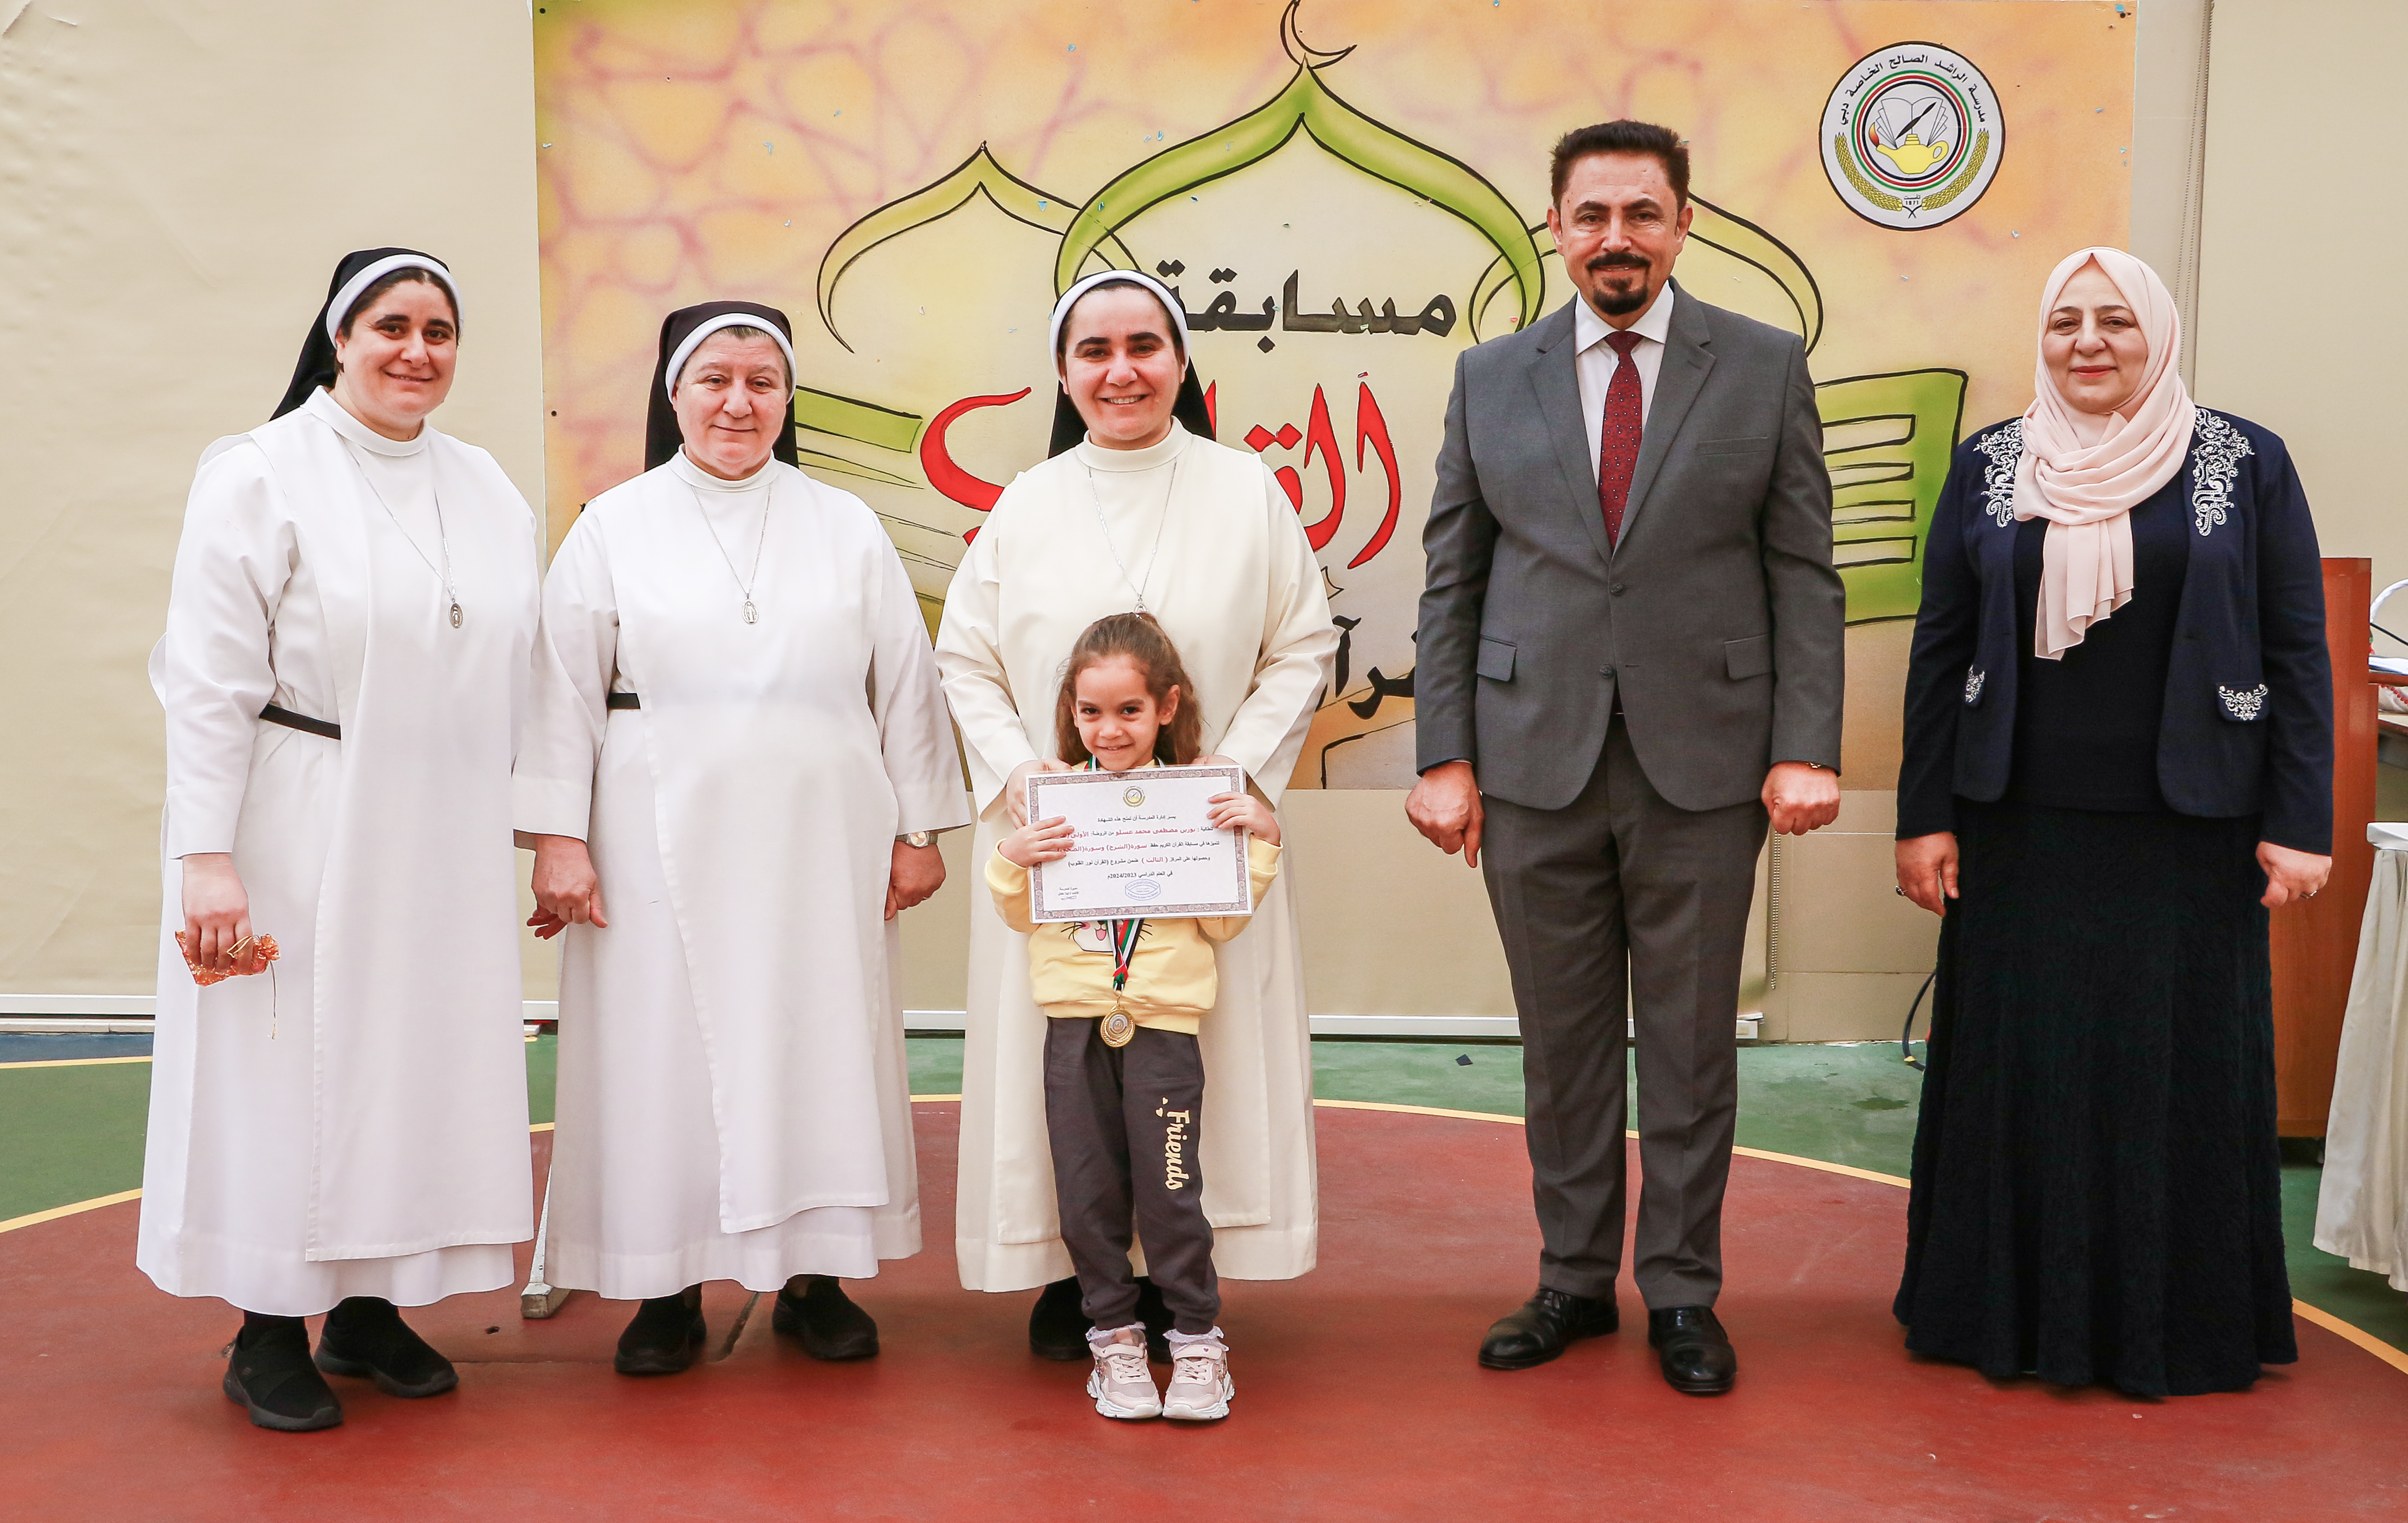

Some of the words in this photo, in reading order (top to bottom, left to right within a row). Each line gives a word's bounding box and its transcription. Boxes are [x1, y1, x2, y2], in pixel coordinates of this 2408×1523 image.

[1889, 54, 1929, 69] الصالح
[1934, 60, 1968, 83] الراشد
[1845, 62, 1884, 97] الخاصة
[1840, 102, 1850, 125] دبي
[1968, 83, 1986, 123] مدرسة
[1165, 1110, 1190, 1191] Friends
